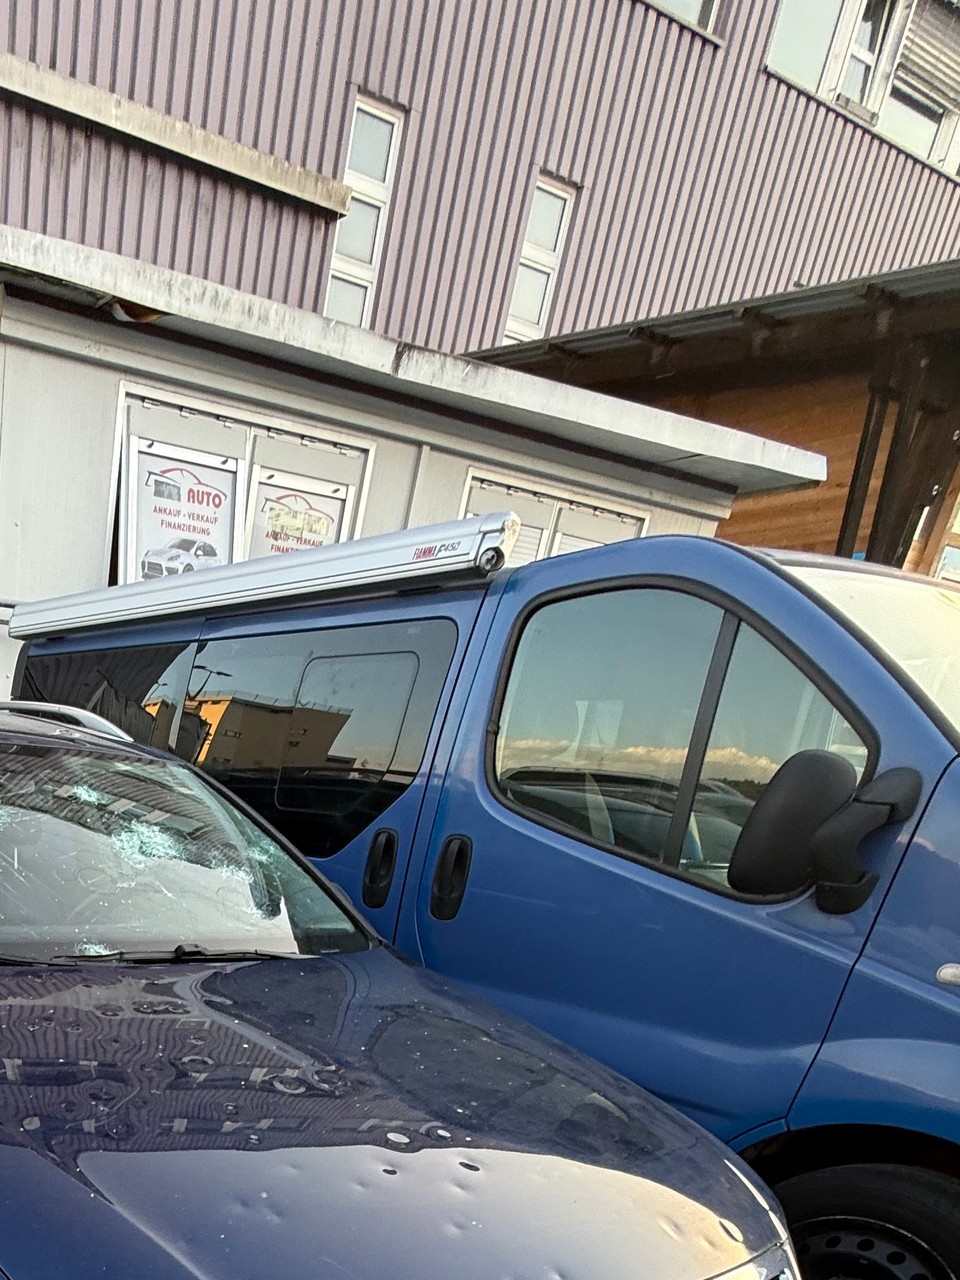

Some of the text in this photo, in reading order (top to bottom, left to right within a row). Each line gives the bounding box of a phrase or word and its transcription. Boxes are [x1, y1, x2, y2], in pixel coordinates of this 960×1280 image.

[187, 488, 222, 509] AUTO
[153, 505, 182, 518] ANKAUF
[187, 513, 219, 525] VERKAUF
[161, 519, 211, 536] FINANZIERUNG
